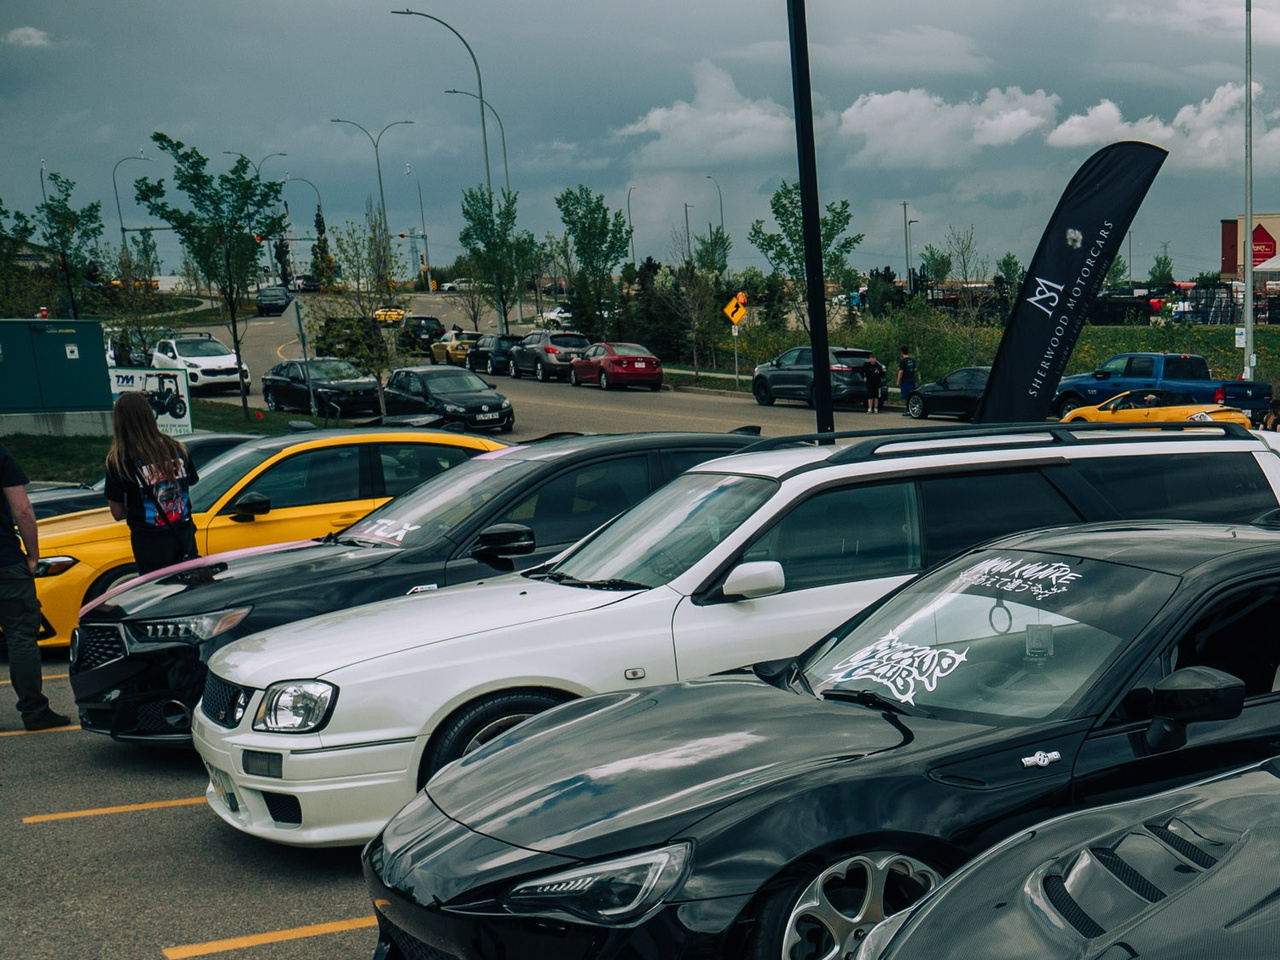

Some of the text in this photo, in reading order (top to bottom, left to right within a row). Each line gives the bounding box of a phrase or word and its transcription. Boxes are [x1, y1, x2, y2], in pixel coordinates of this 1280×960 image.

[1028, 219, 1114, 398] SHERWOOD MOTORCARS
[115, 374, 135, 385] TYM
